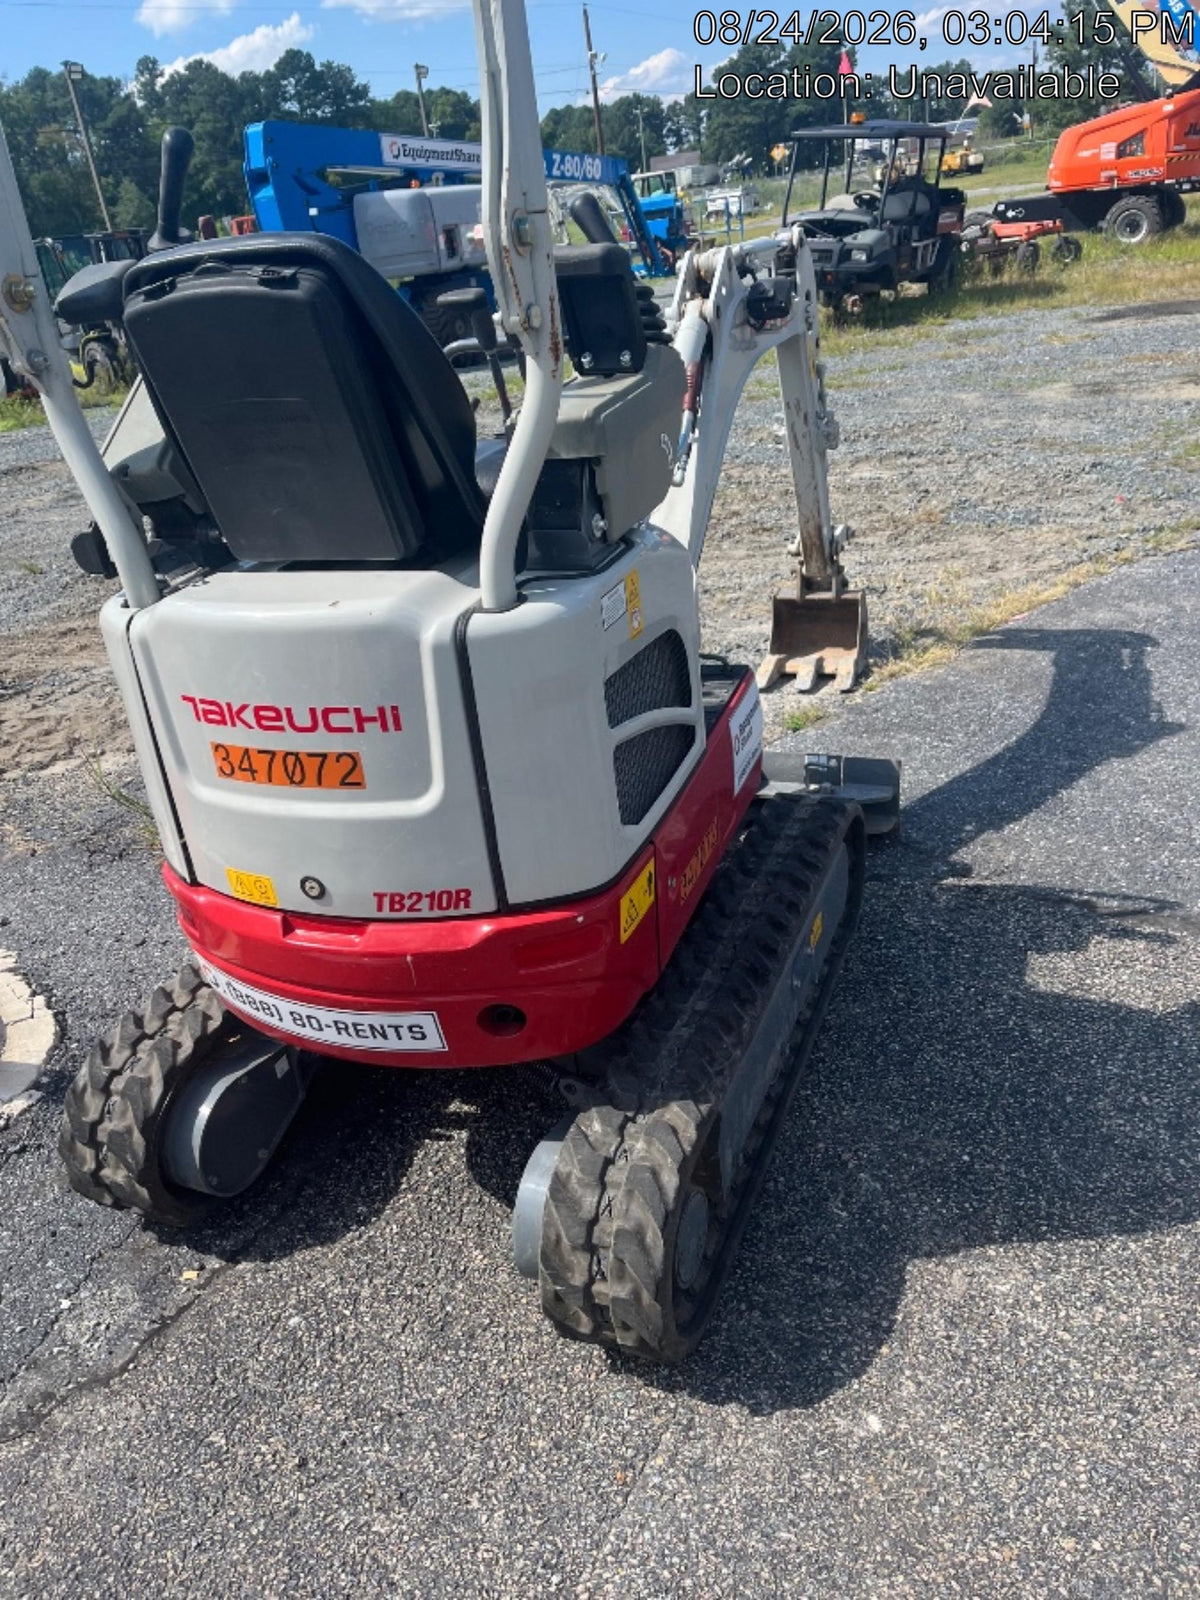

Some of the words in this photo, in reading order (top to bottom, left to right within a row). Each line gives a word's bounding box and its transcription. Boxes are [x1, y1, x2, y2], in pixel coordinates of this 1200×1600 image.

[402, 143, 481, 163] EquipmentShare
[552, 153, 602, 181] Z-80/60
[213, 743, 363, 787] 347072
[373, 888, 472, 913] TB210R
[289, 1010, 428, 1042] 80-RENTS
